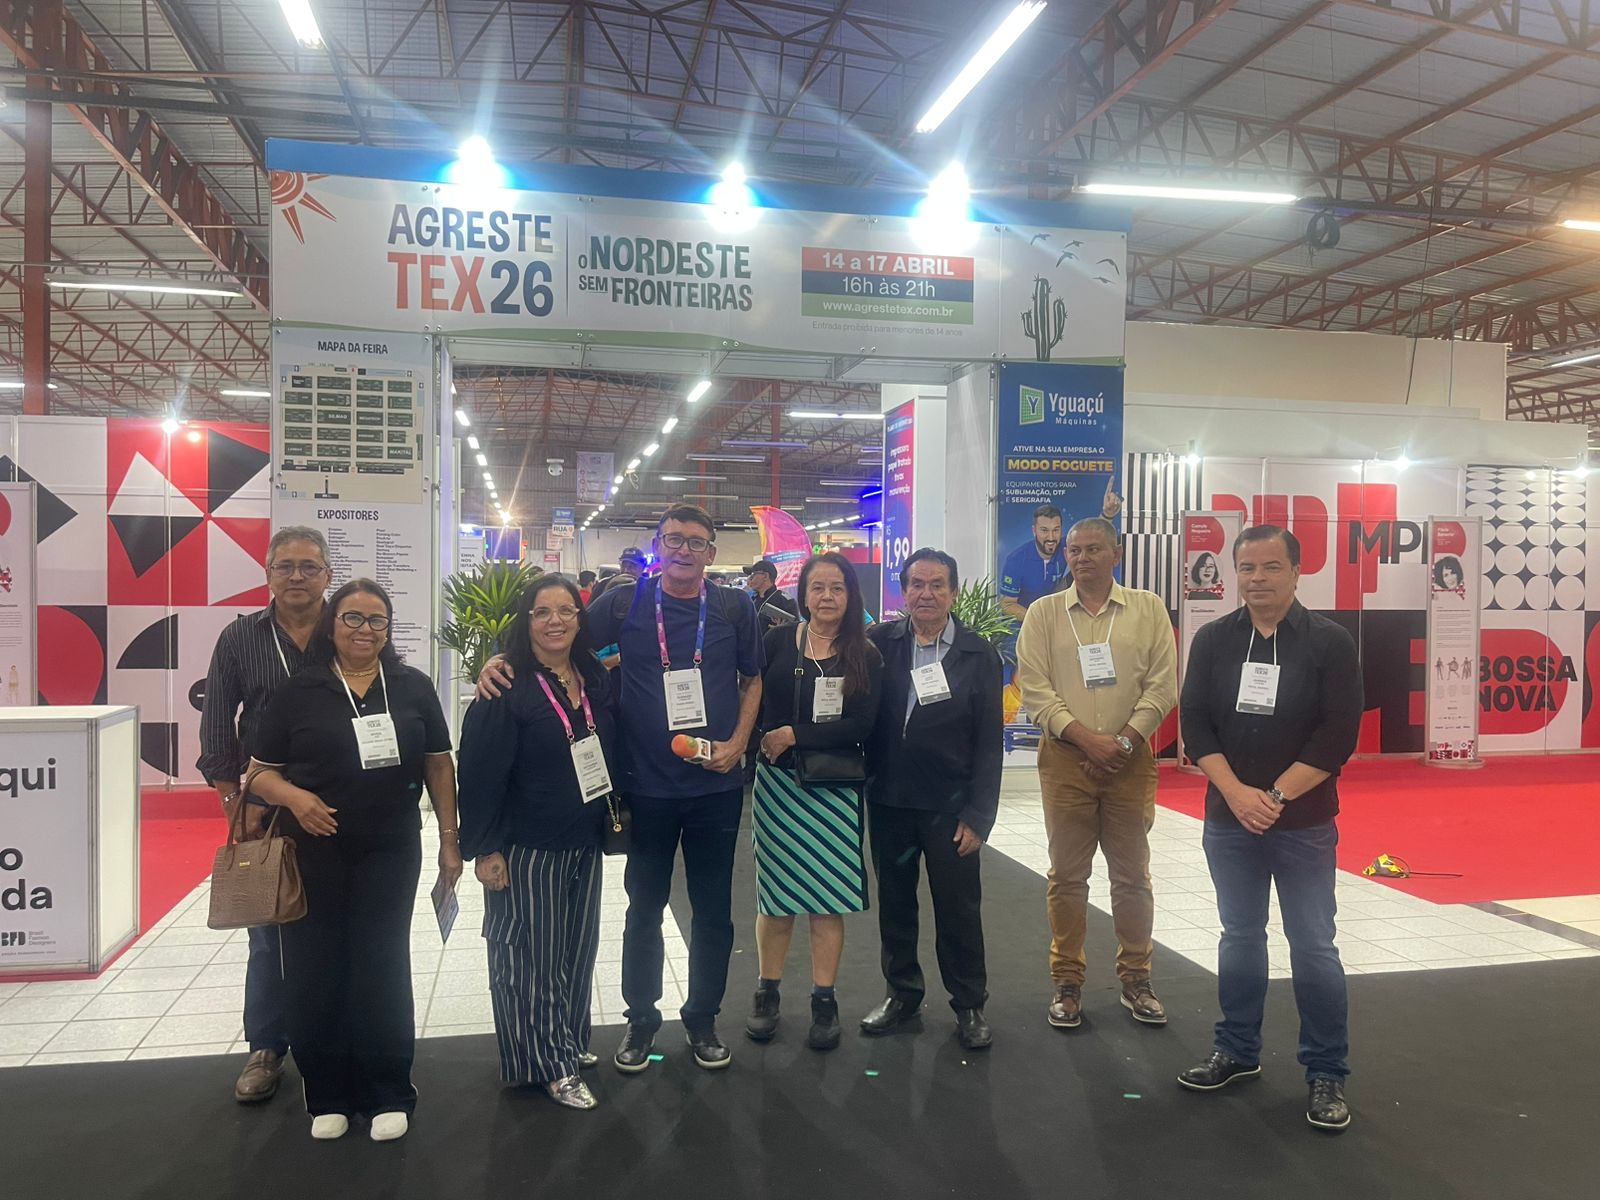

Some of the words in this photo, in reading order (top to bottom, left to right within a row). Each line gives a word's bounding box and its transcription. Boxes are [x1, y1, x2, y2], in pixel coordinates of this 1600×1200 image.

[387, 204, 554, 253] AGRESTE
[578, 254, 588, 269] O
[590, 235, 752, 279] NORDESTE
[823, 252, 845, 269] 14
[850, 257, 861, 270] a
[867, 255, 888, 272] 17
[892, 256, 955, 276] ABRIL
[387, 251, 554, 317] TEX26
[578, 275, 608, 292] SEM
[611, 277, 753, 312] FRONTEIRAS
[842, 276, 873, 294] 16h
[879, 278, 900, 295] às
[905, 280, 935, 297] 21h
[823, 301, 954, 317] www.agrestetex.com.br
[812, 320, 841, 330] Entrada
[318, 341, 346, 352] MAPA
[348, 342, 360, 353] DA
[363, 343, 388, 354] FEIRA
[1026, 395, 1040, 415] Y
[1049, 392, 1104, 417] Yguaçú
[1055, 417, 1097, 426] Máquinas
[1063, 446, 1097, 454] EMPRESA
[1008, 459, 1050, 471] MODO
[1052, 460, 1113, 471] FOGUETE
[1006, 488, 1052, 496] SUBLIMAÇÃO,
[317, 509, 379, 521] EXPOSITORES
[886, 536, 910, 569] 1,99
[1479, 656, 1578, 682] BOSSA
[1479, 685, 1557, 712] NOVA
